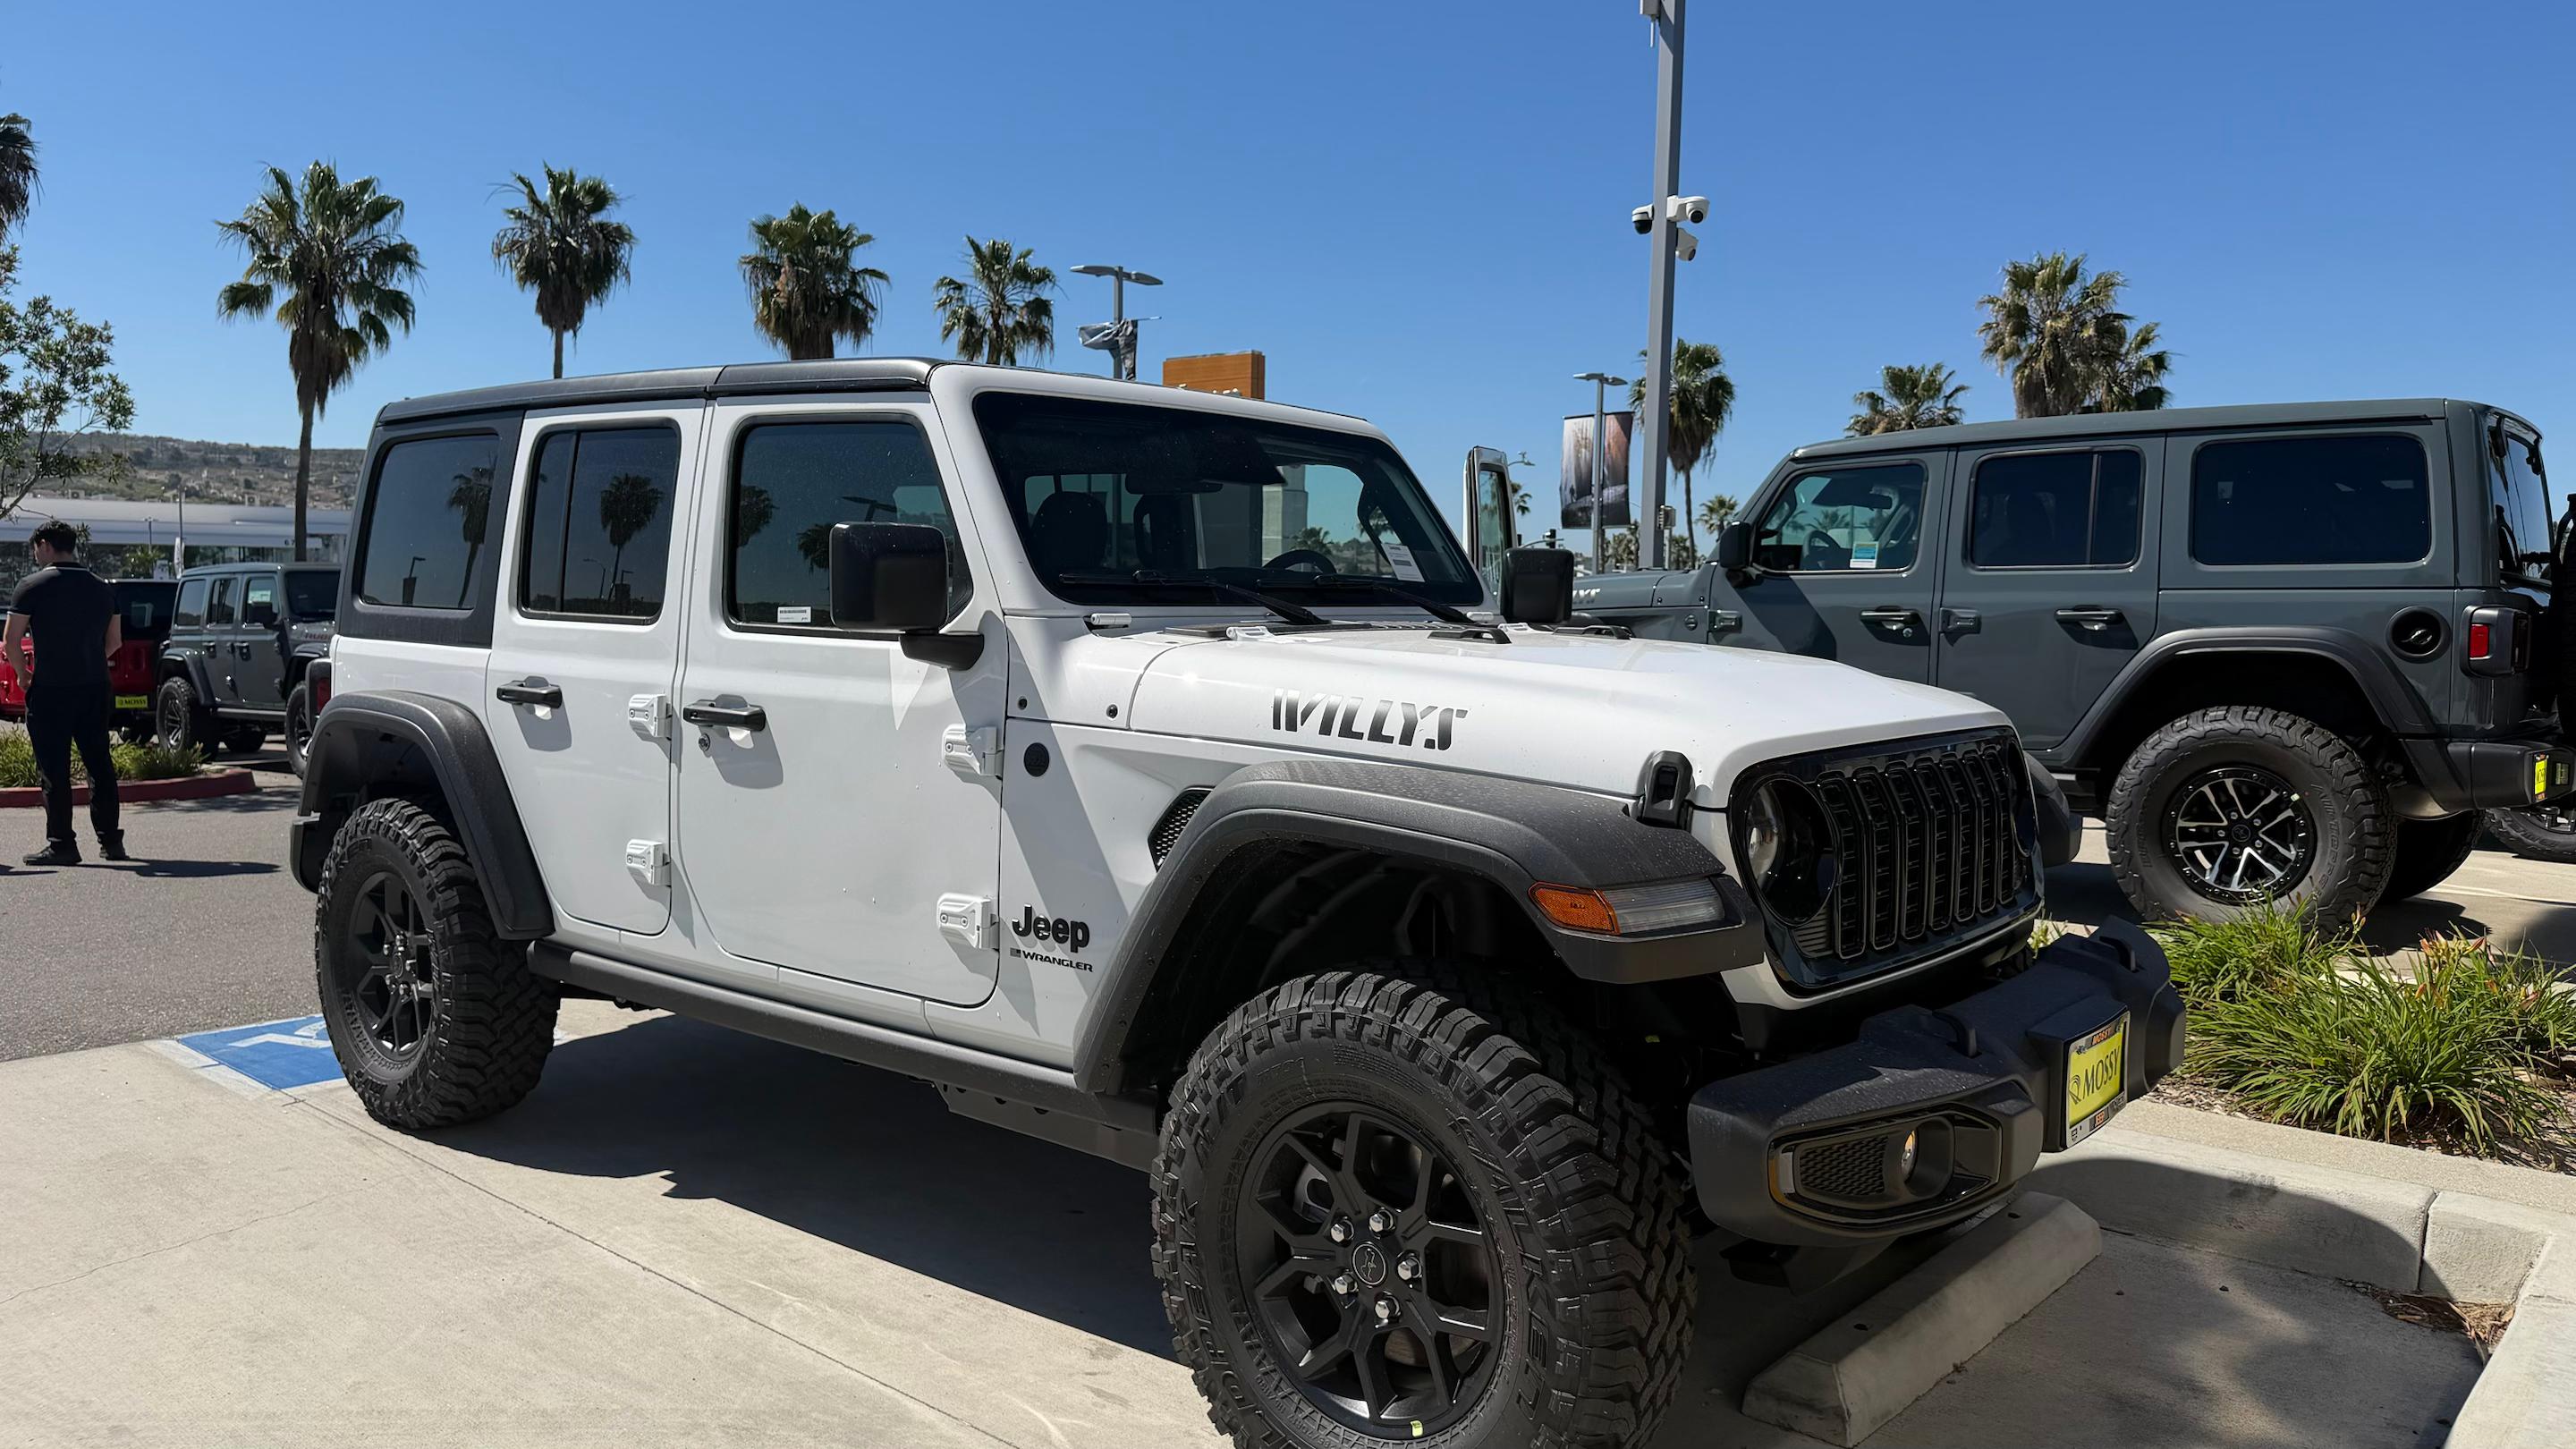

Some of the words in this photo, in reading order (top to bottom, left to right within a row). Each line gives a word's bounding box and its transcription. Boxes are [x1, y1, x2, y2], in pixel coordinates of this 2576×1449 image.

[1273, 688, 1469, 751] WILLYS
[1012, 903, 1089, 953] Jeep
[1022, 950, 1093, 973] WRANGLER
[2082, 1045, 2121, 1100] MOSSY
